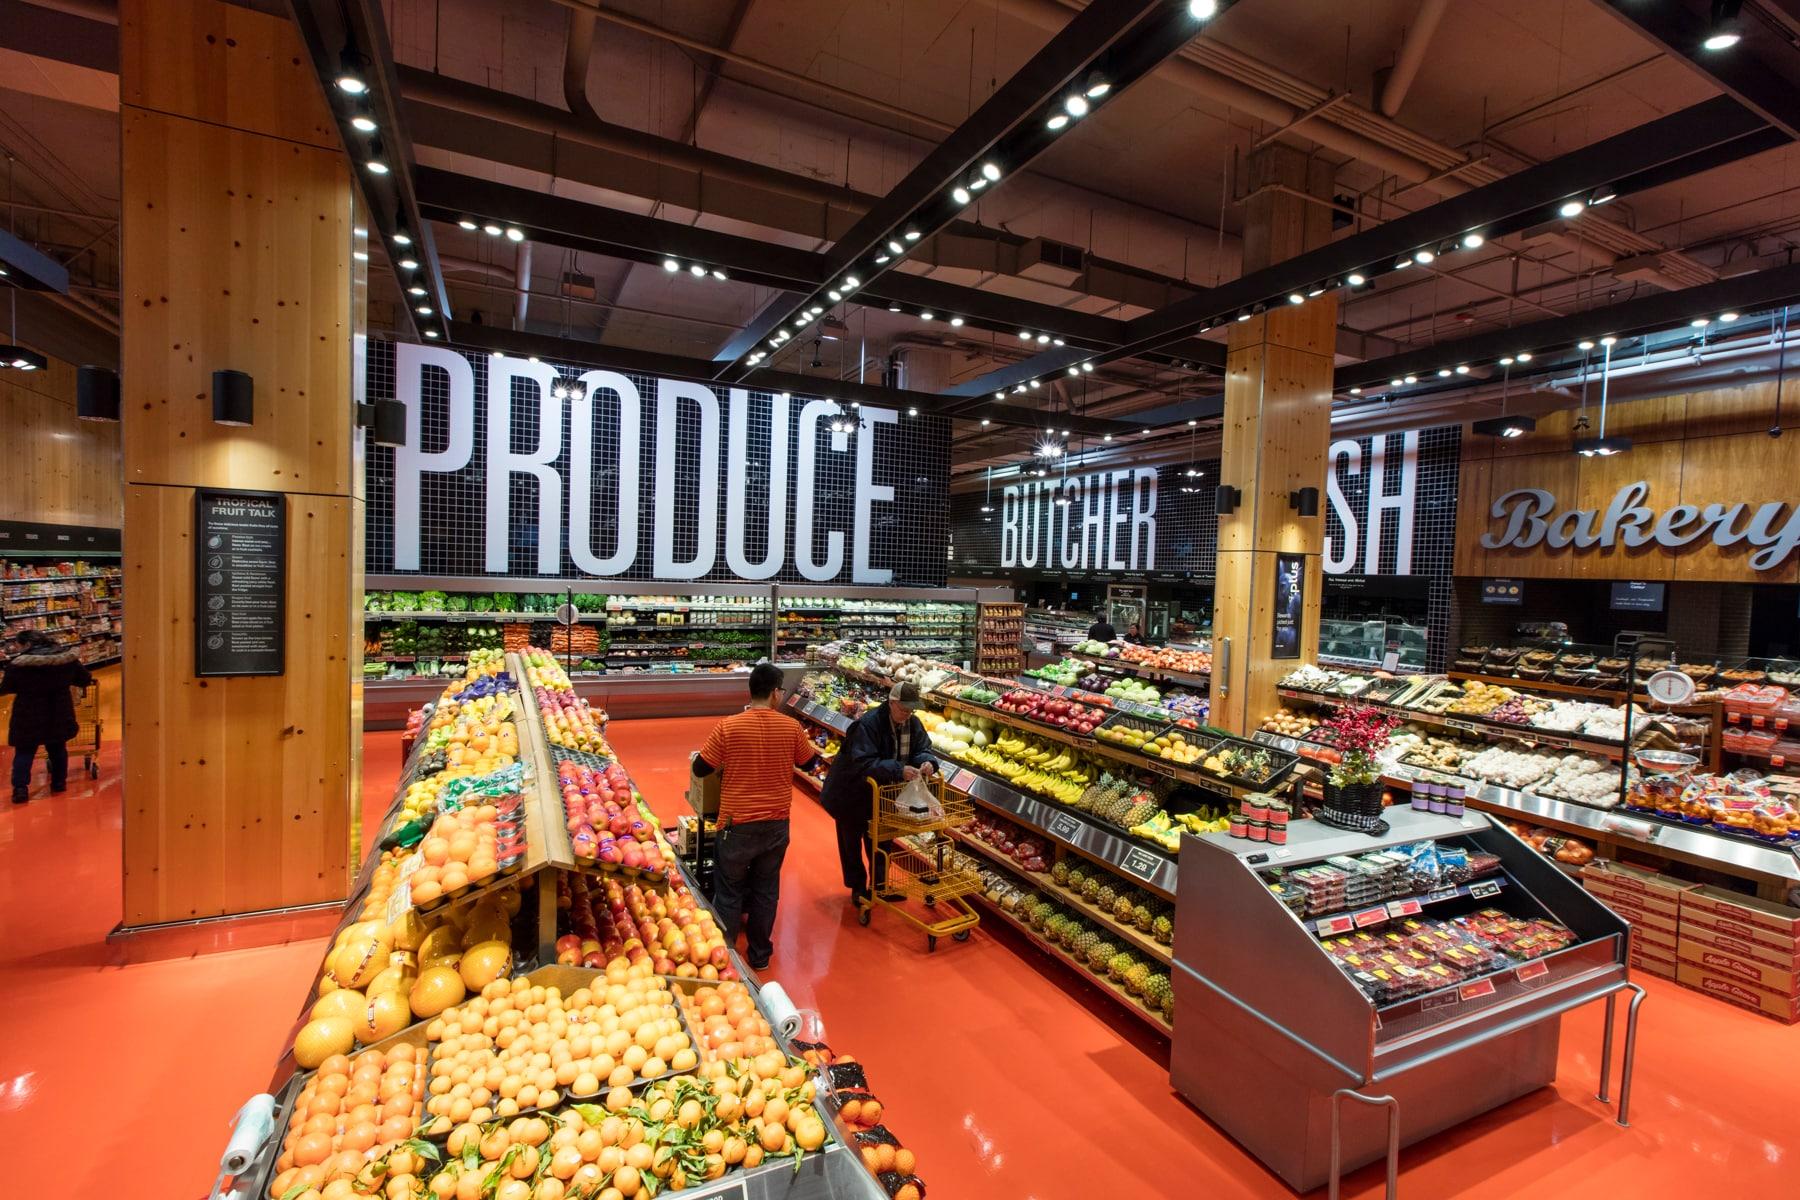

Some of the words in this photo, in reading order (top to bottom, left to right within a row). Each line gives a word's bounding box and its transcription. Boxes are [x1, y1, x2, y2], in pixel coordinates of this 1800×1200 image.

[216, 498, 273, 509] TROPICAL
[394, 342, 900, 584] PRODUCE
[1323, 430, 1419, 575] SH
[212, 507, 246, 516] FRUIT
[248, 509, 276, 518] TALK
[1001, 467, 1158, 570] BUTCHER
[1480, 480, 1800, 571] Bakery
[1288, 562, 1300, 593] plus
